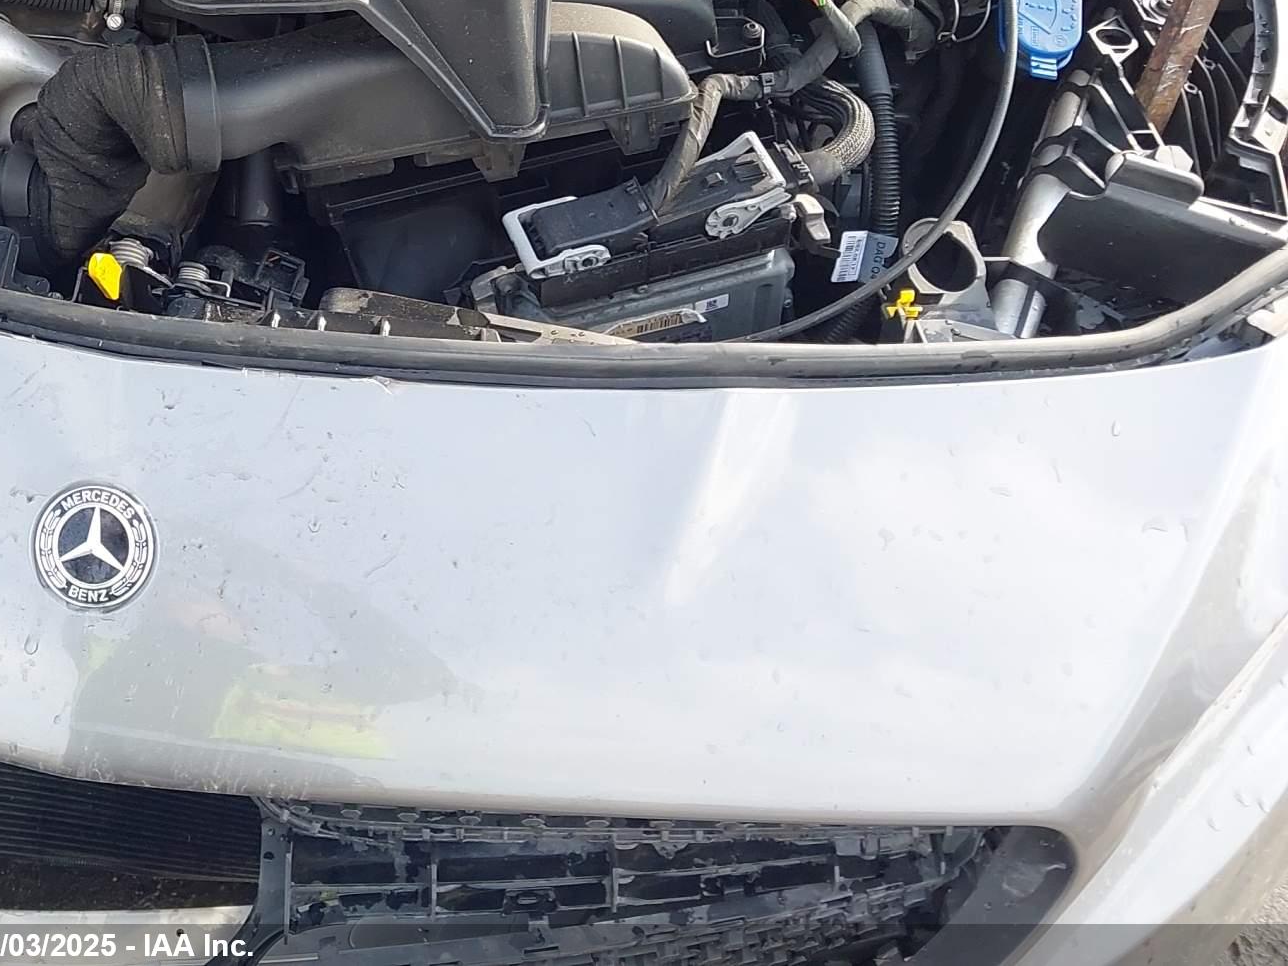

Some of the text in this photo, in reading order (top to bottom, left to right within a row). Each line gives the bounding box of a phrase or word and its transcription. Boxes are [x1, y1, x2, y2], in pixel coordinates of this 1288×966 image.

[874, 241, 886, 263] DAG
[60, 490, 135, 519] MERCEDES
[68, 587, 110, 602] BENZ
